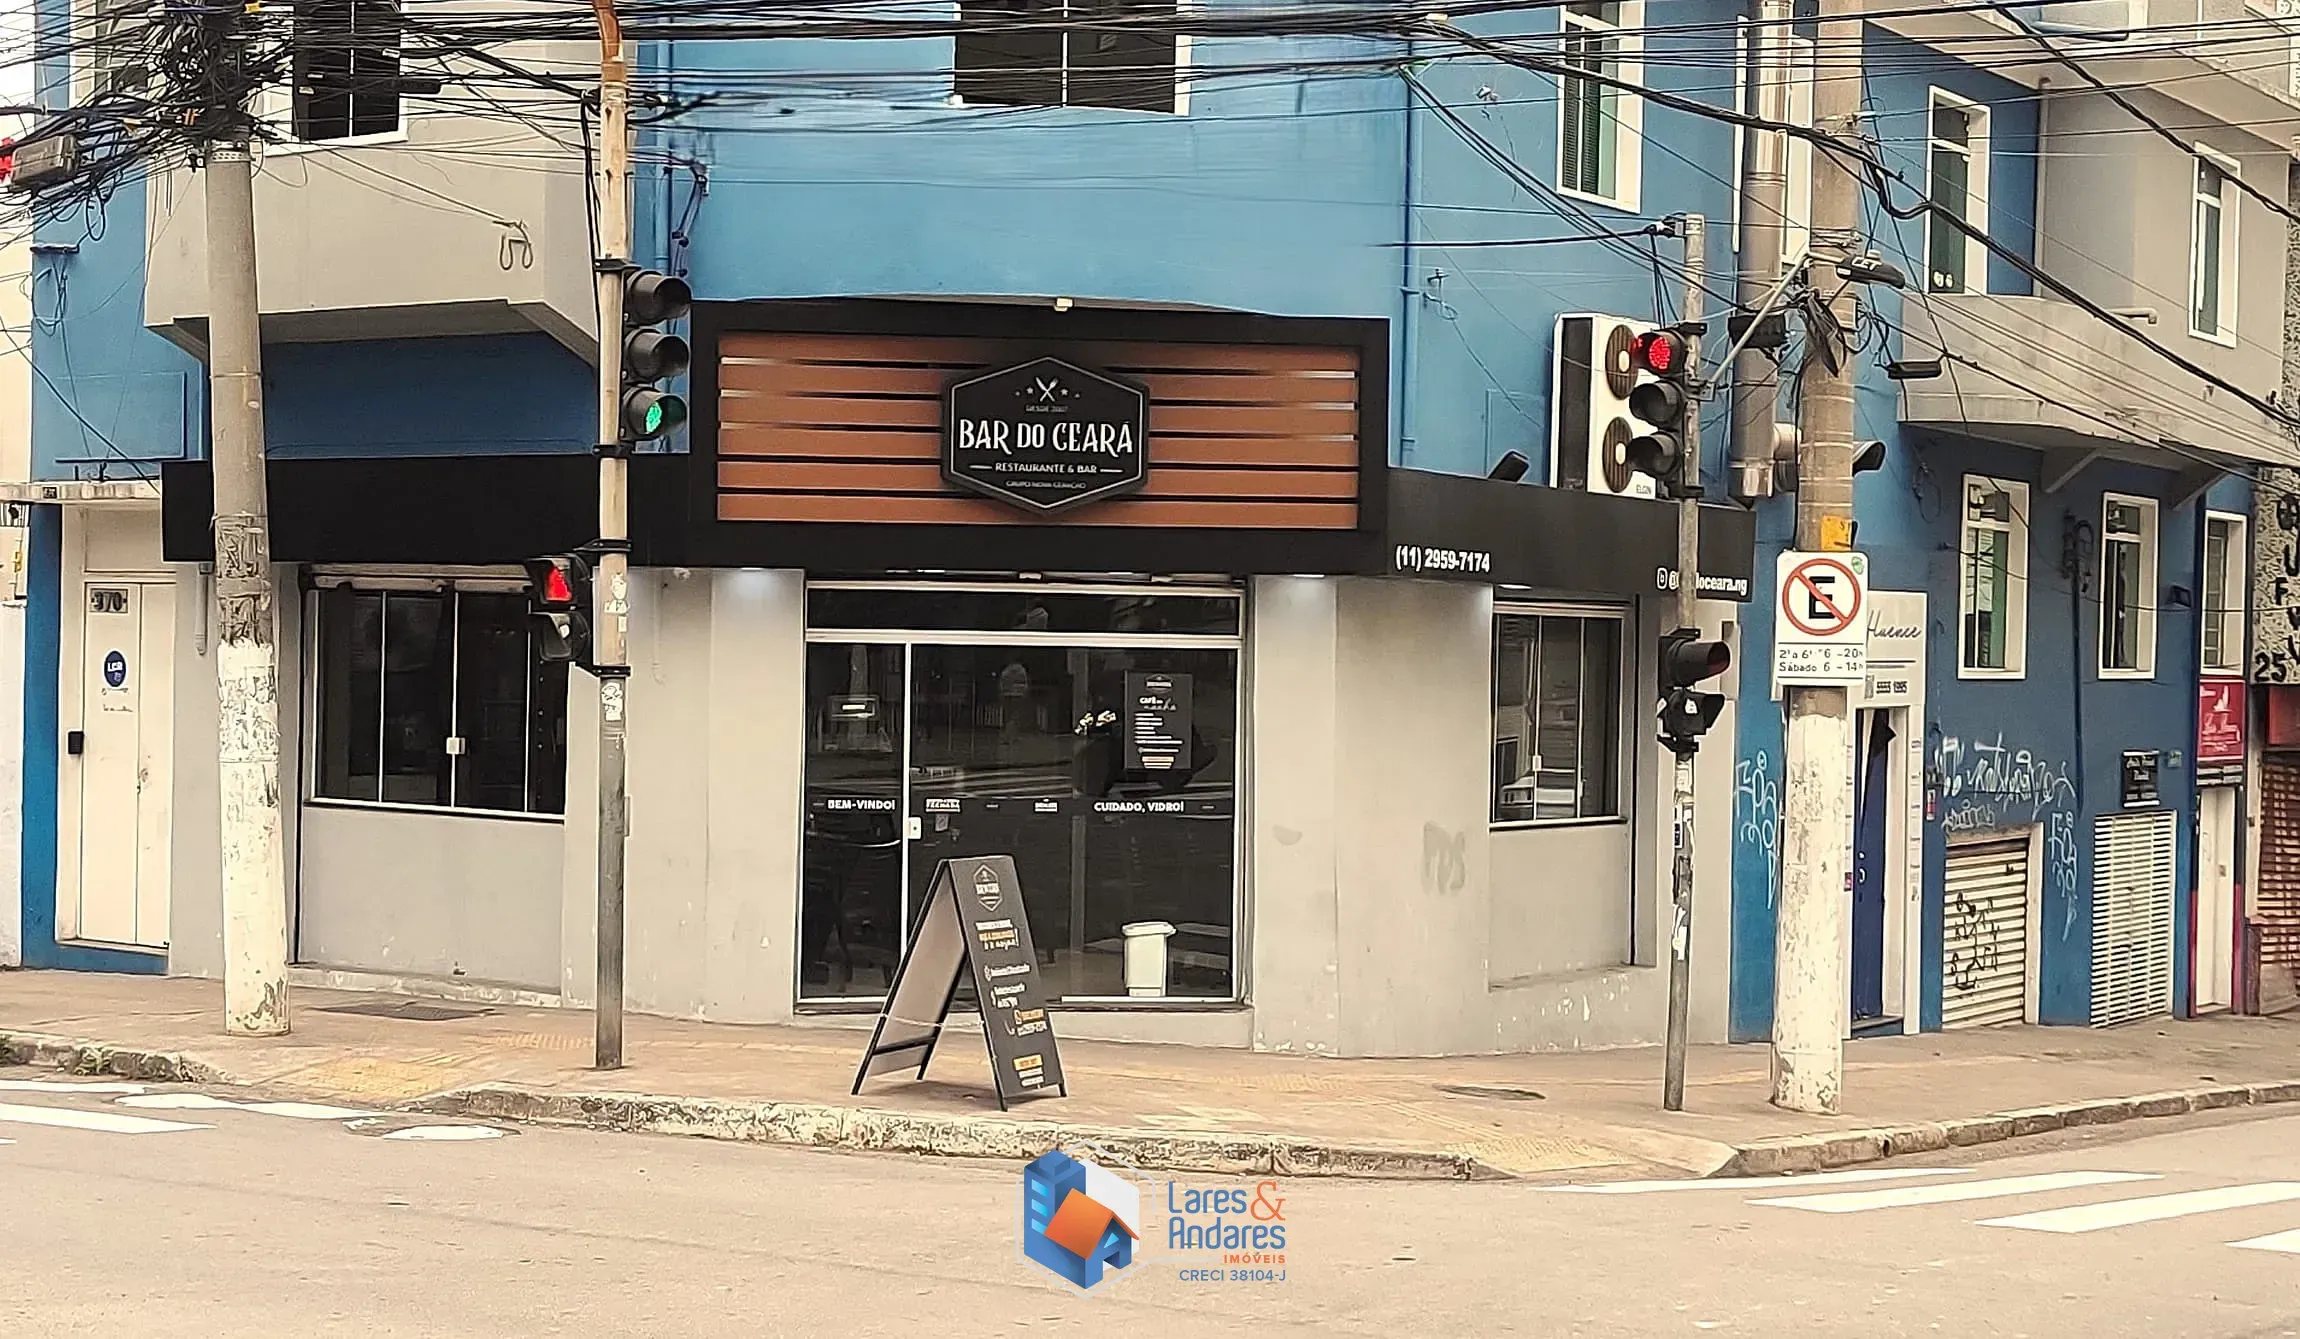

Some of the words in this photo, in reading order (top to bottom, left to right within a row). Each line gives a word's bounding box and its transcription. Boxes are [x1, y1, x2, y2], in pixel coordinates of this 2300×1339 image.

[1852, 256, 1882, 271] CET
[959, 418, 1013, 455] BAR
[1017, 422, 1046, 449] DO
[995, 462, 1066, 473] RESTAURANTE
[1077, 464, 1097, 474] BAR
[1395, 544, 1422, 573] (11)
[1424, 548, 1491, 573] 2959-7174
[1808, 576, 1836, 620] E
[827, 799, 897, 811] BEM-VINDO!
[1093, 801, 1146, 814] CUIDADO,
[1147, 801, 1184, 813] VIDRO!
